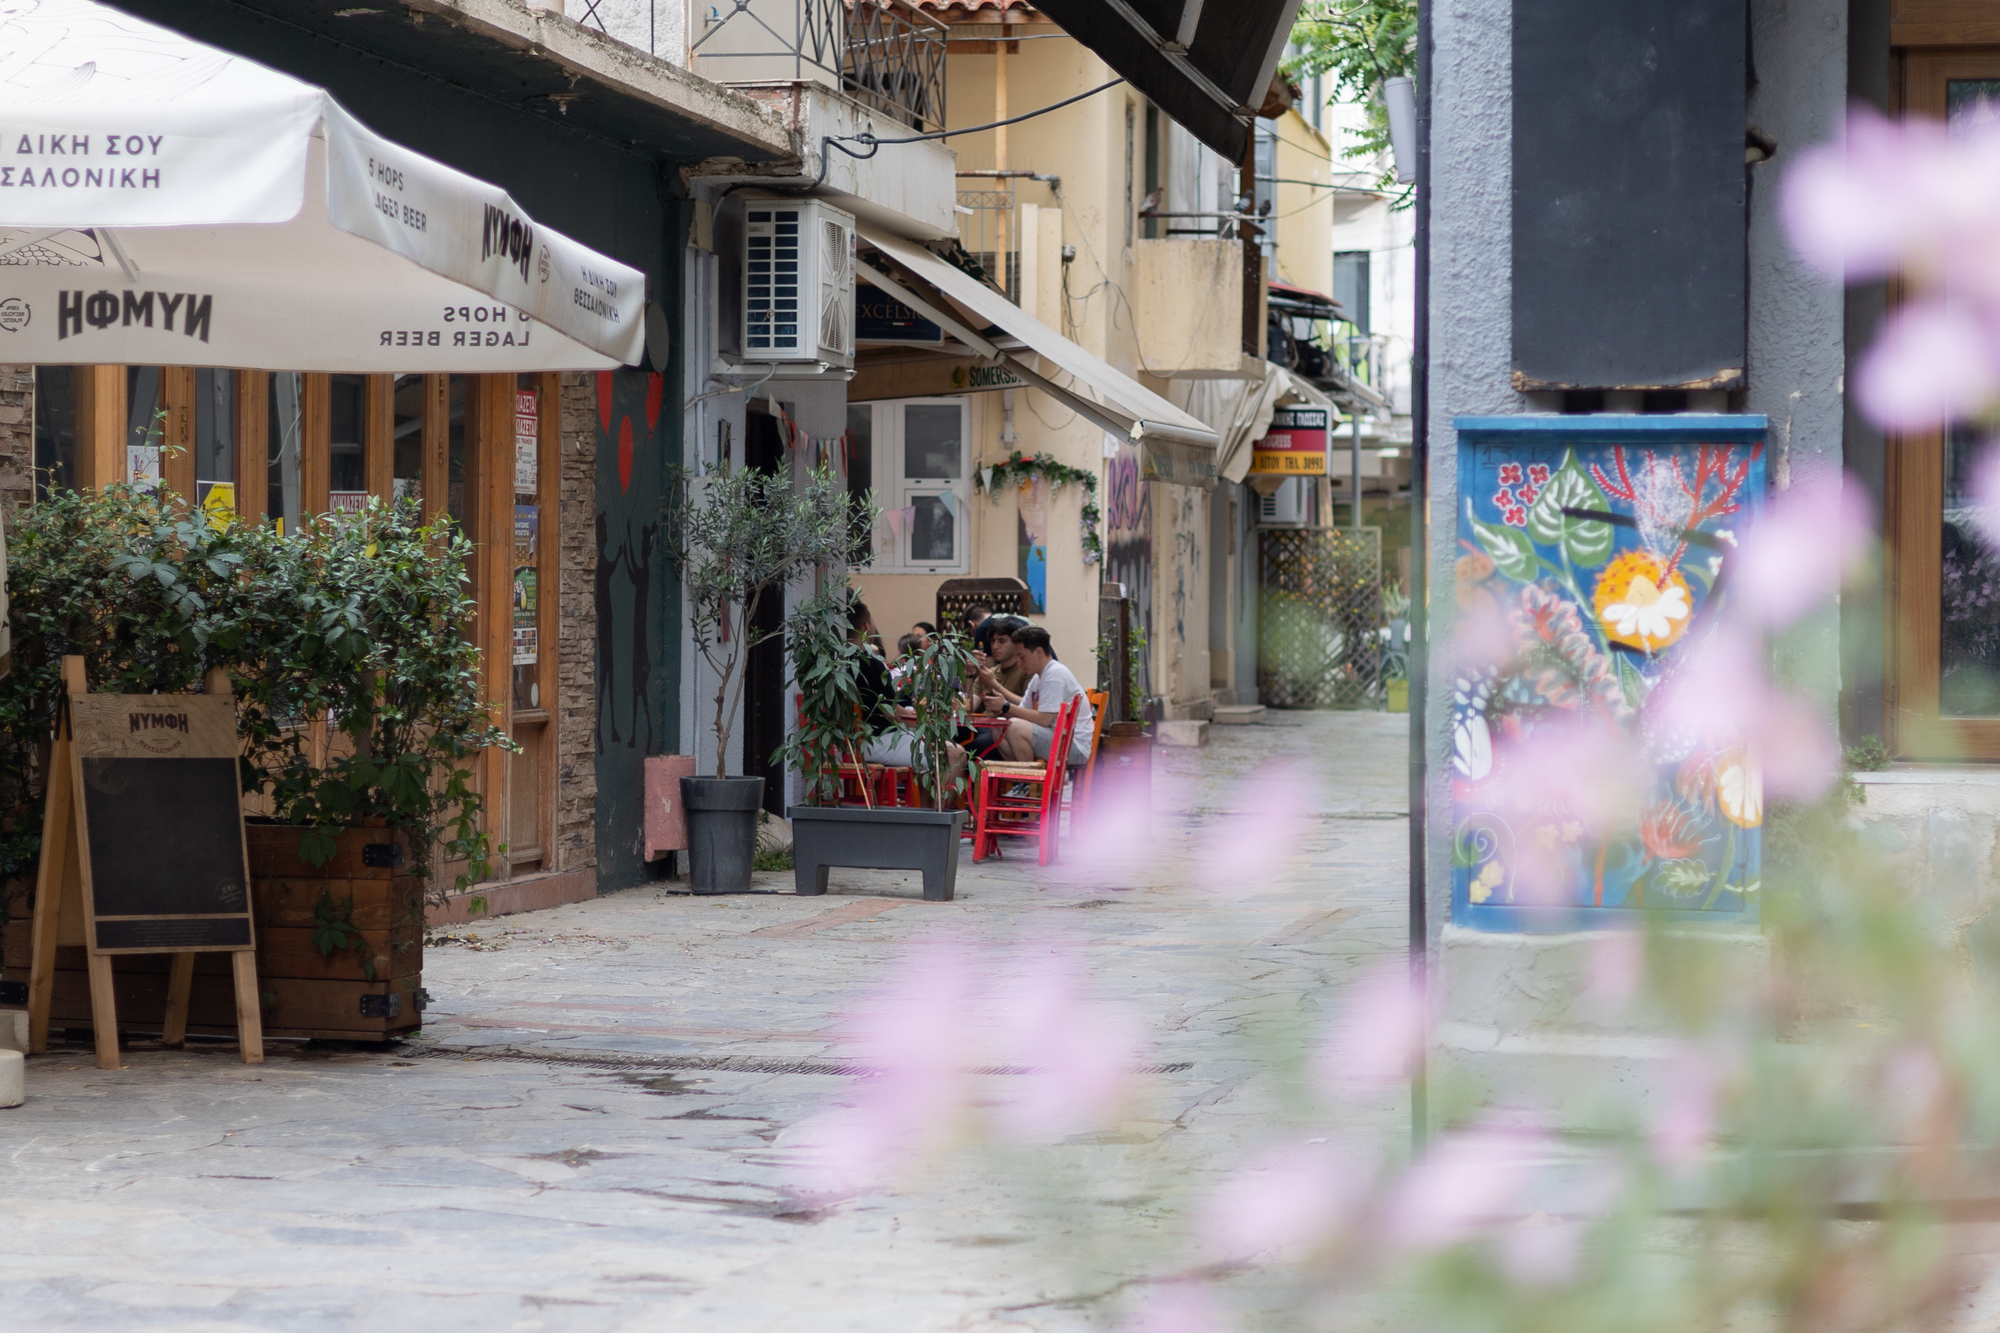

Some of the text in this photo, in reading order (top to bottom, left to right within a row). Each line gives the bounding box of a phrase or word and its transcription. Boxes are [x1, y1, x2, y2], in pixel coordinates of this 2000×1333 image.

[16, 133, 164, 156] ΔΙΚΗ ΣΟΥ
[369, 157, 404, 192] 5 HOPS
[403, 204, 427, 233] BEER
[969, 365, 1021, 387] SOMERS
